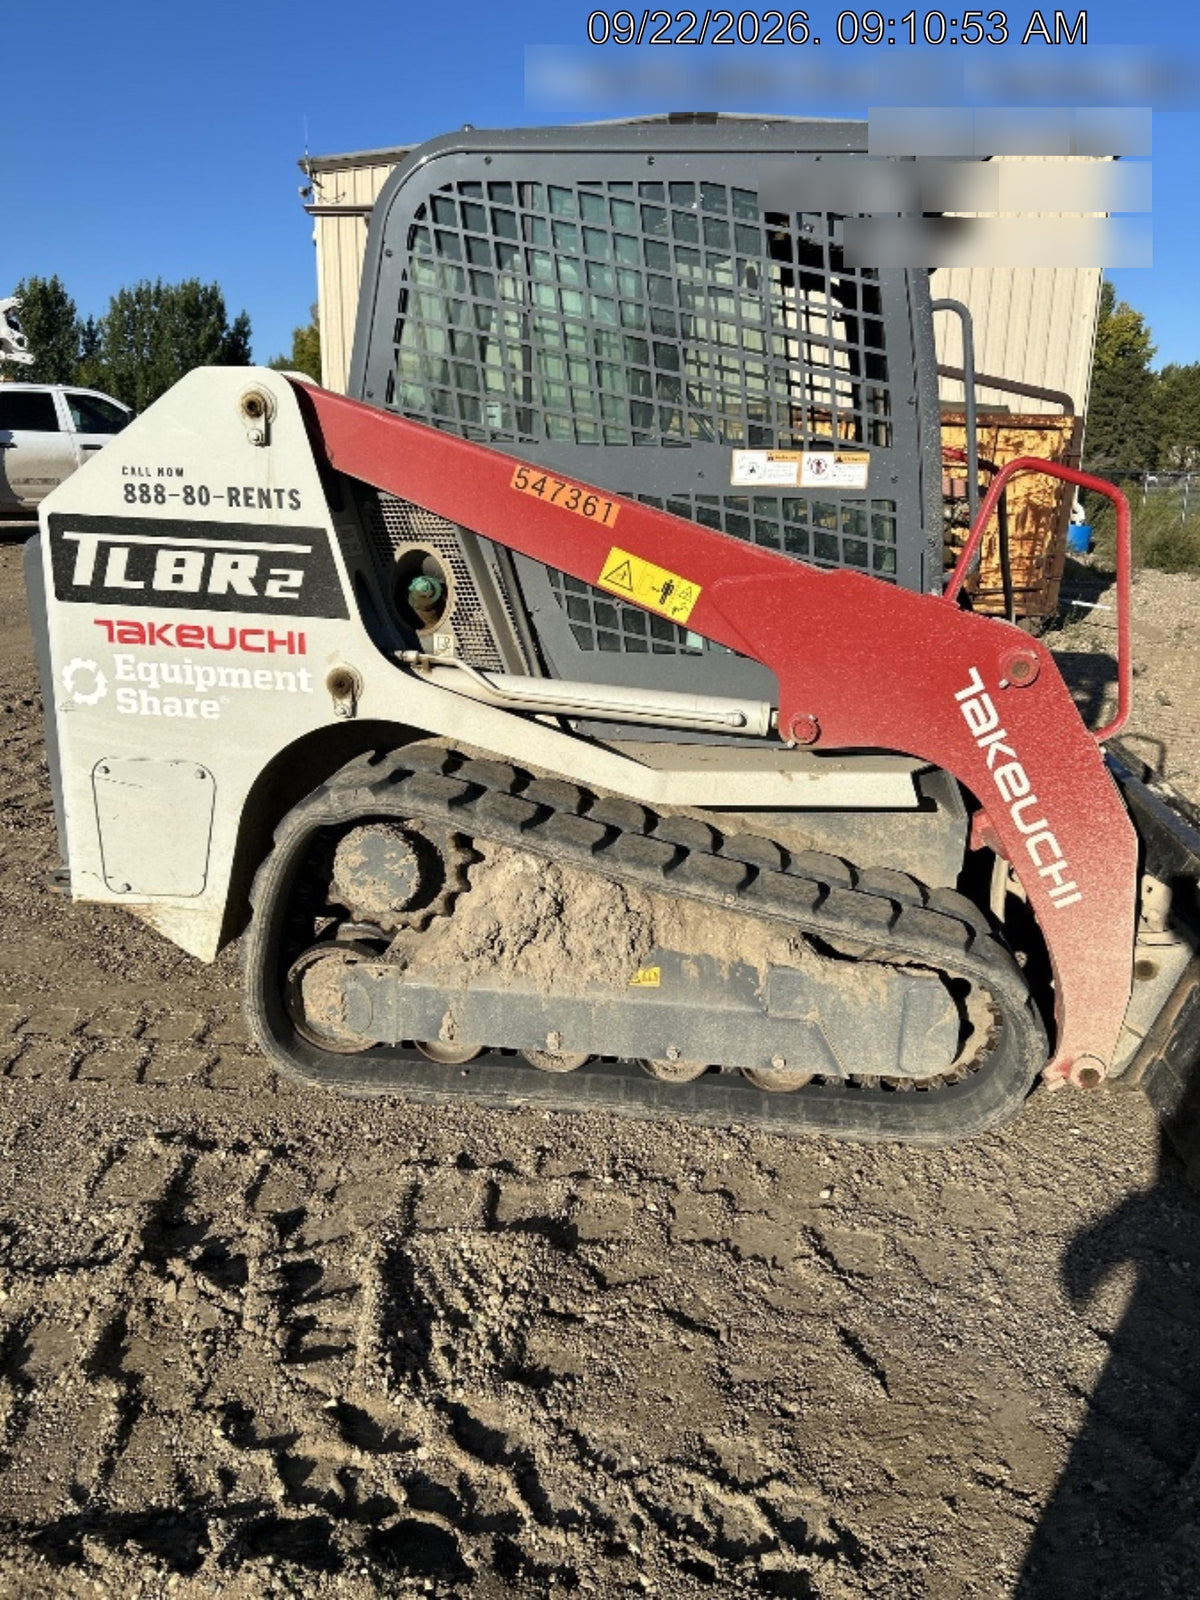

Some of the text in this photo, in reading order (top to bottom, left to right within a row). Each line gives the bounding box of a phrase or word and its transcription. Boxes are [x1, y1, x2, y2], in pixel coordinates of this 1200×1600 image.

[121, 465, 151, 477] CALL
[123, 483, 301, 510] 888-80-RENTS
[514, 467, 613, 523] 547361
[114, 655, 313, 692] Equipment
[115, 687, 221, 720] Share
